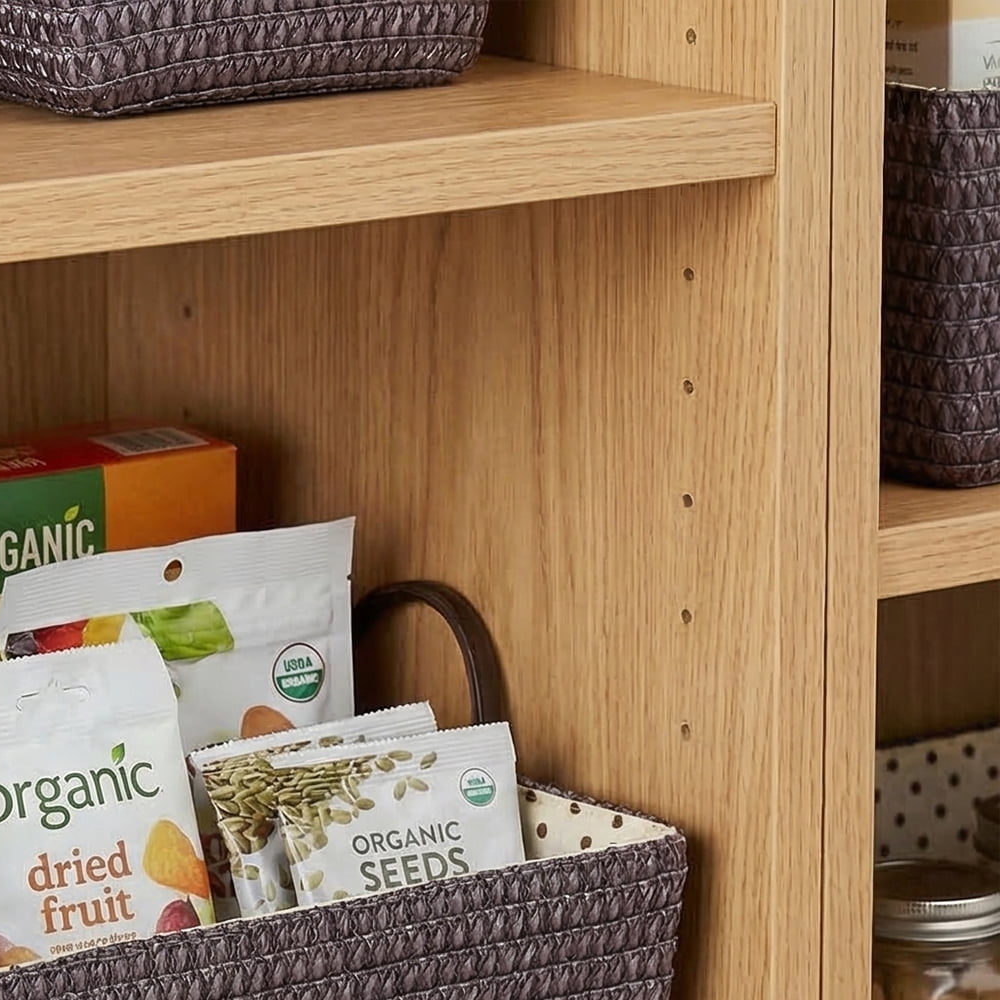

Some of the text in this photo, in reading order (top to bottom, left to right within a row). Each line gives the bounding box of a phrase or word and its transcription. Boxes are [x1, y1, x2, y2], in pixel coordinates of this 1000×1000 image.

[283, 656, 313, 672] USDA
[352, 821, 462, 855] ORGANIC
[27, 840, 133, 892] dried
[360, 847, 470, 892] SEEDS
[40, 886, 135, 934] fruit
